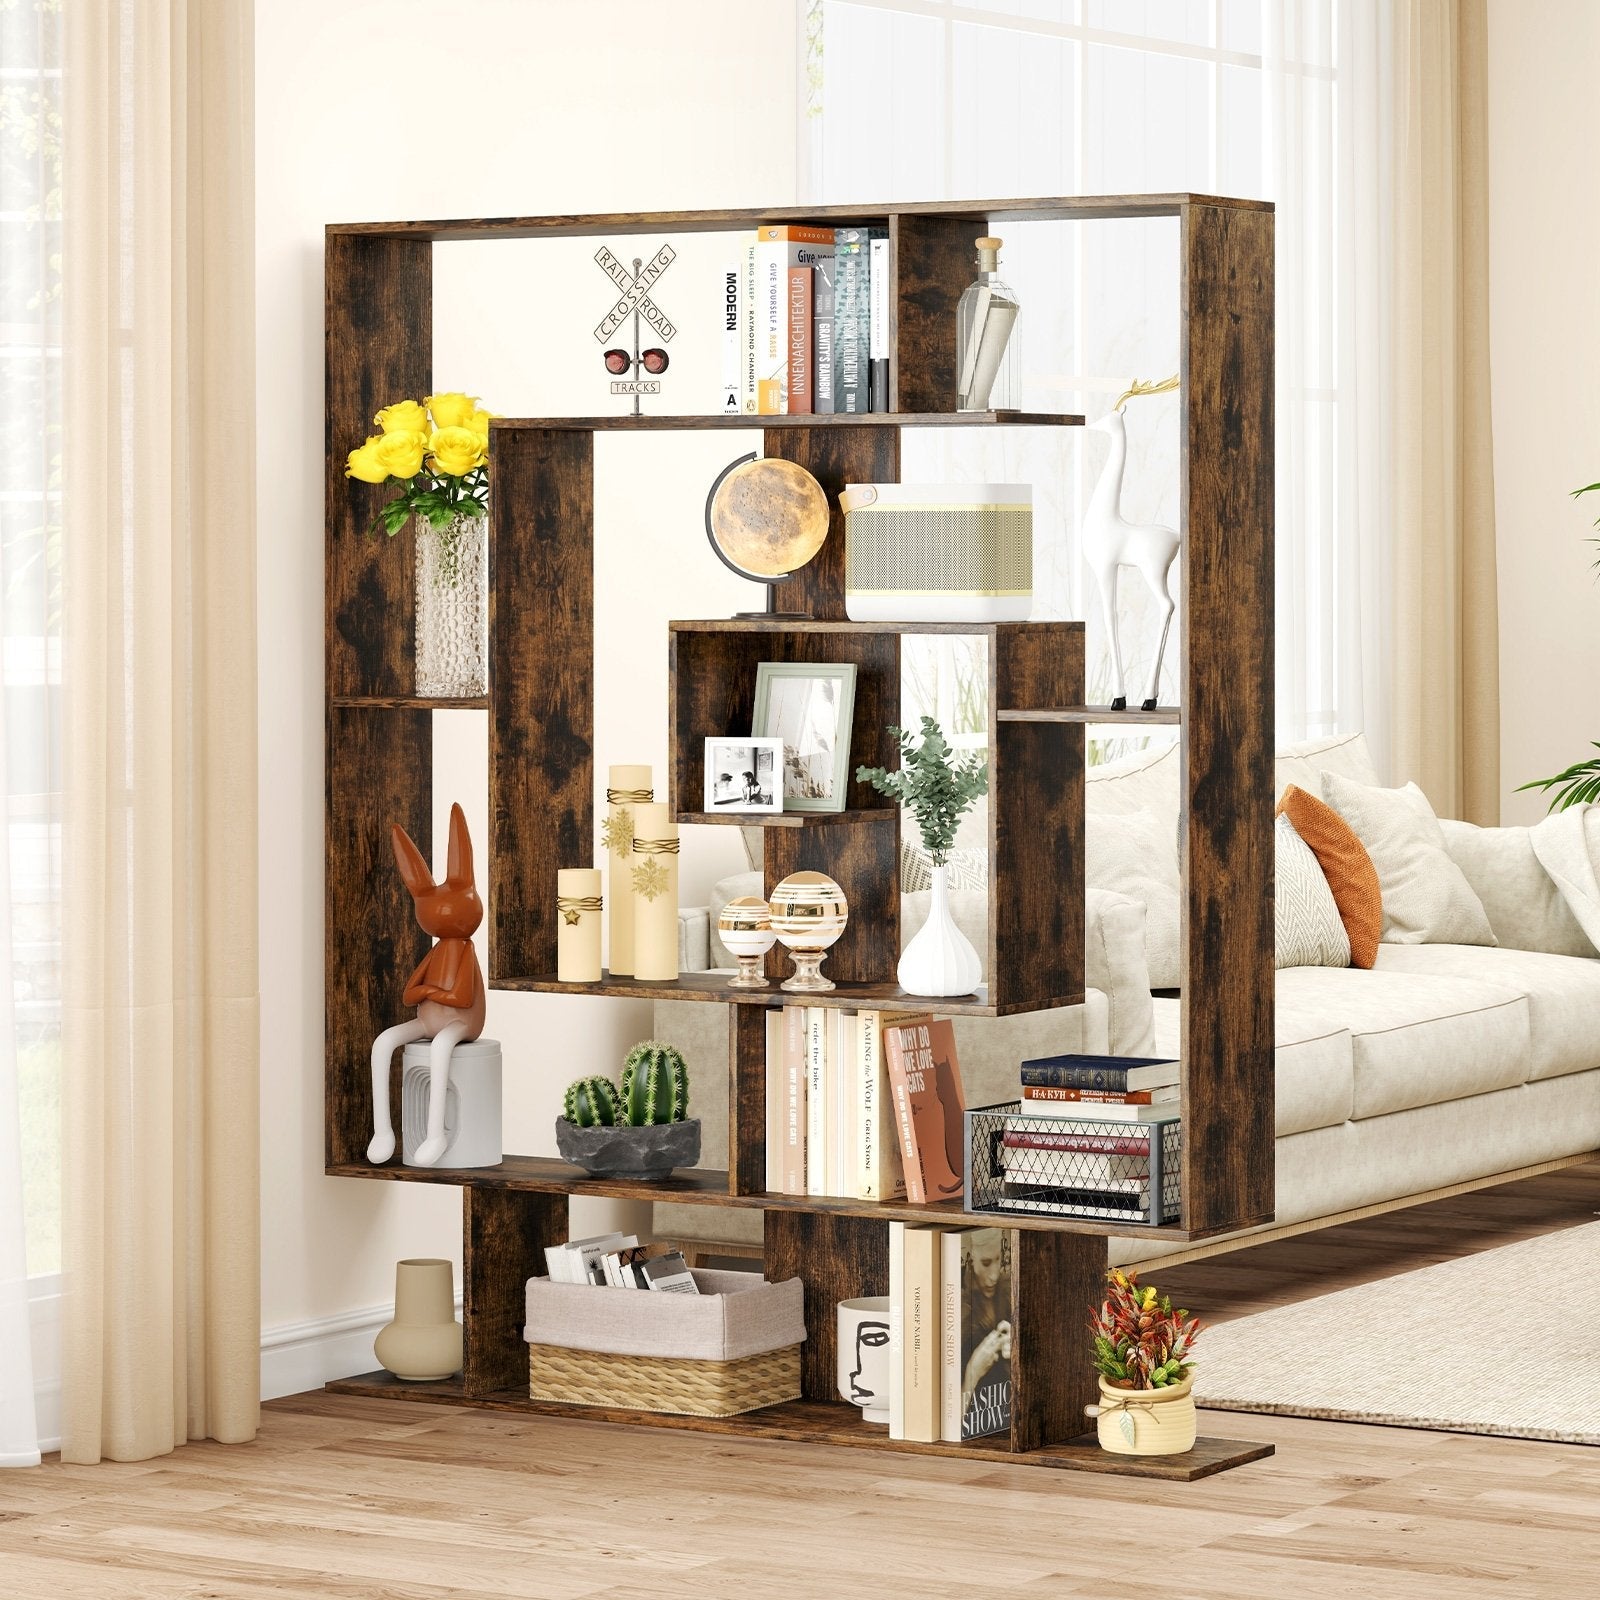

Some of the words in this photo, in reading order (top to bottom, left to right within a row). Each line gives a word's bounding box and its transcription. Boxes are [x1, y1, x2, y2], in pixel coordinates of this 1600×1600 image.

[798, 249, 816, 263] Give
[600, 252, 627, 287] RAIL
[640, 298, 672, 336] ROAD
[600, 252, 670, 336] CROSSING
[726, 272, 737, 331] MODERN
[792, 277, 804, 395] INNENARCHITEKTUR
[818, 323, 830, 362] GRAVITY'S
[615, 383, 656, 393] TRACKS
[818, 363, 830, 400] RAINBOW
[726, 394, 736, 406] A
[864, 1016, 873, 1062] TAMING
[900, 1027, 917, 1050] WHY
[918, 1026, 930, 1048] DO
[903, 1050, 916, 1072] WE
[916, 1048, 934, 1070] LOVE
[790, 1084, 796, 1094] DO
[864, 1079, 874, 1112] WOLF
[906, 1072, 925, 1094] CATS
[790, 1096, 796, 1106] WE
[900, 1101, 906, 1112] DO
[901, 1112, 908, 1123] WE
[902, 1124, 910, 1141] LOVE
[905, 1141, 914, 1158] CATS
[946, 1283, 954, 1332] FASHION
[946, 1334, 954, 1368] SHOW
[962, 1380, 1012, 1415] FASHIO
[962, 1405, 1004, 1437] SHOW
